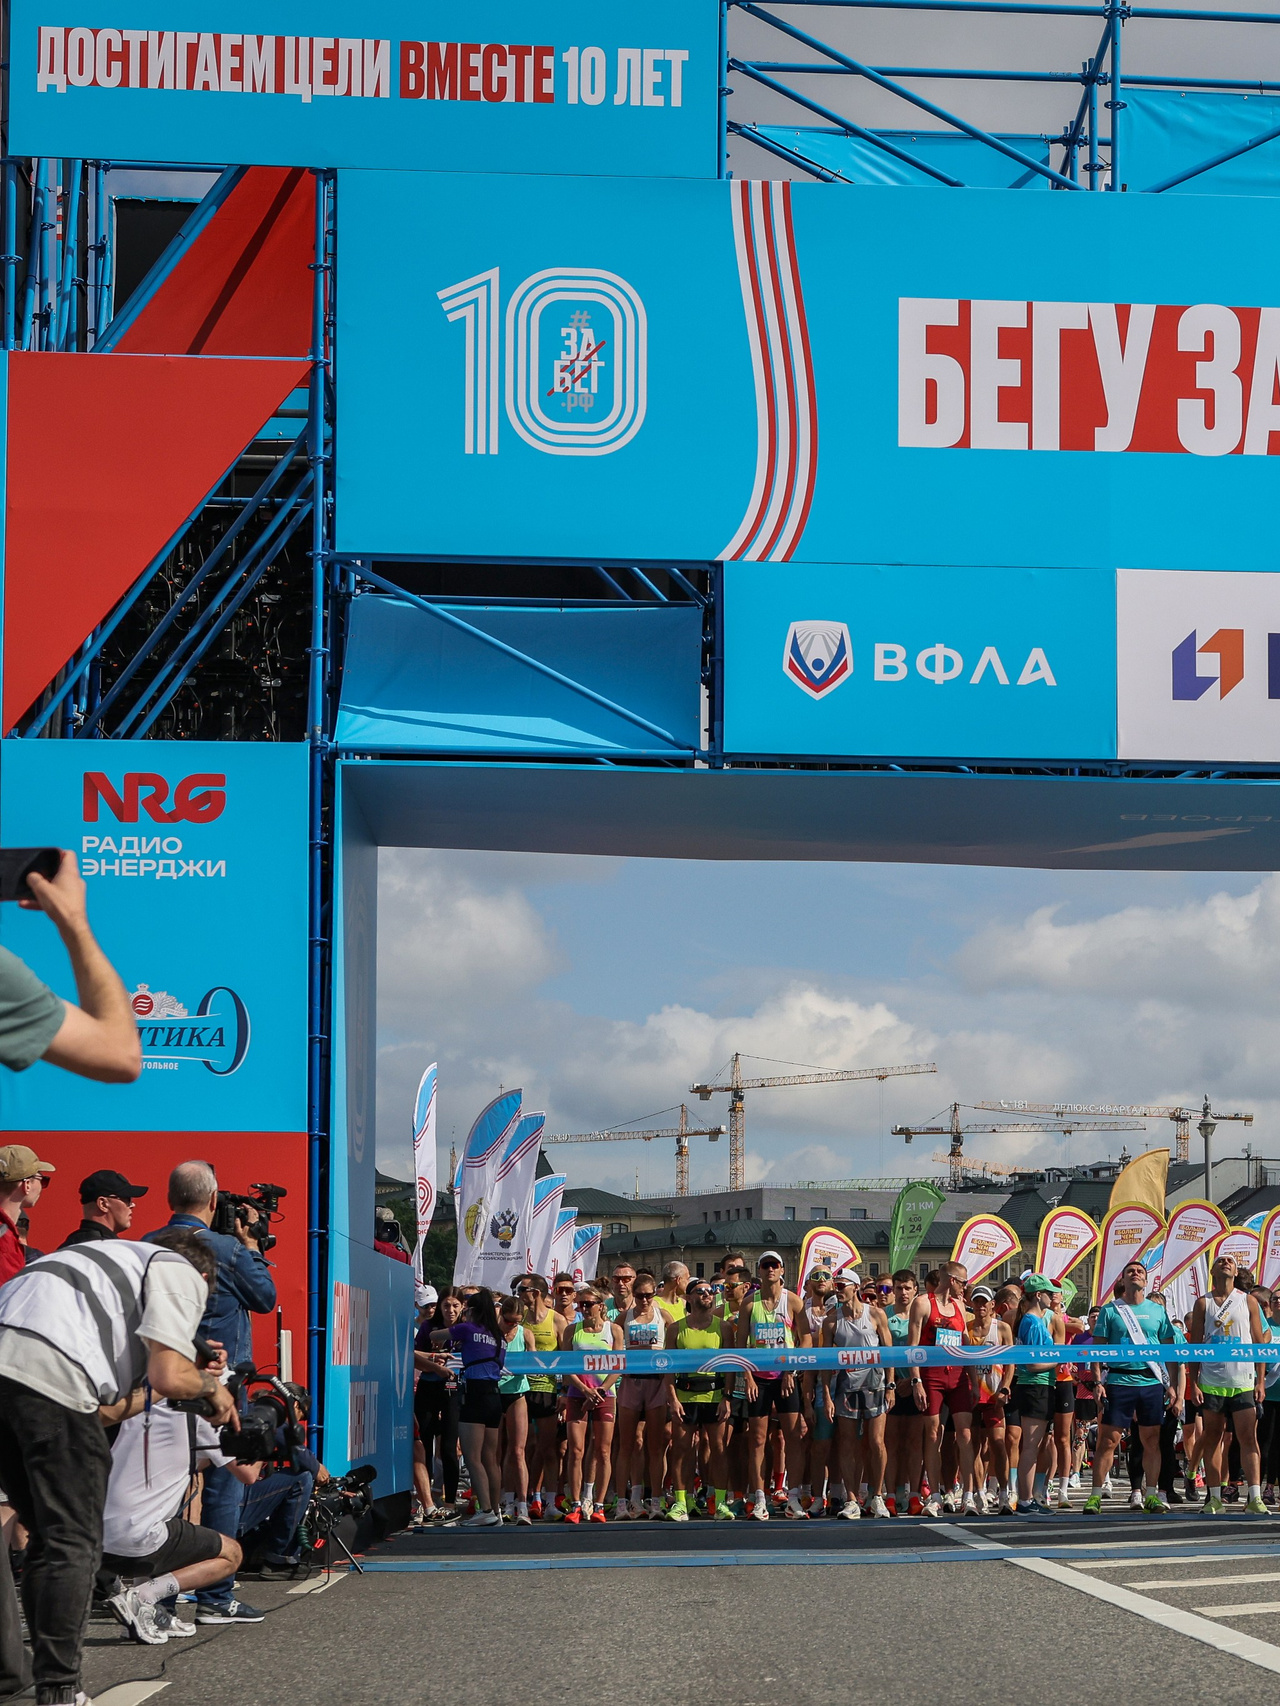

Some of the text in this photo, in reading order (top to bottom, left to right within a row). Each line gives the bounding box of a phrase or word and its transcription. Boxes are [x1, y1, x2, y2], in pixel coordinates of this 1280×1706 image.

[37, 26, 689, 108] ДОСТИГАЕМ ЦЕЛИ ВМЕСТЕ 10 ЛЕТ
[899, 297, 1157, 453] БЕГУ
[873, 642, 1057, 686] ВФЛА
[82, 772, 227, 824] NRG
[82, 837, 183, 856] РАДИО
[82, 859, 227, 880] ЭНЕРДЖИ
[905, 1202, 916, 1211] 21
[789, 1355, 816, 1364] ПСБ
[838, 1350, 880, 1365] СТАРТ
[1230, 1348, 1253, 1357] 21,1
[584, 1354, 626, 1371] СТАРТ
